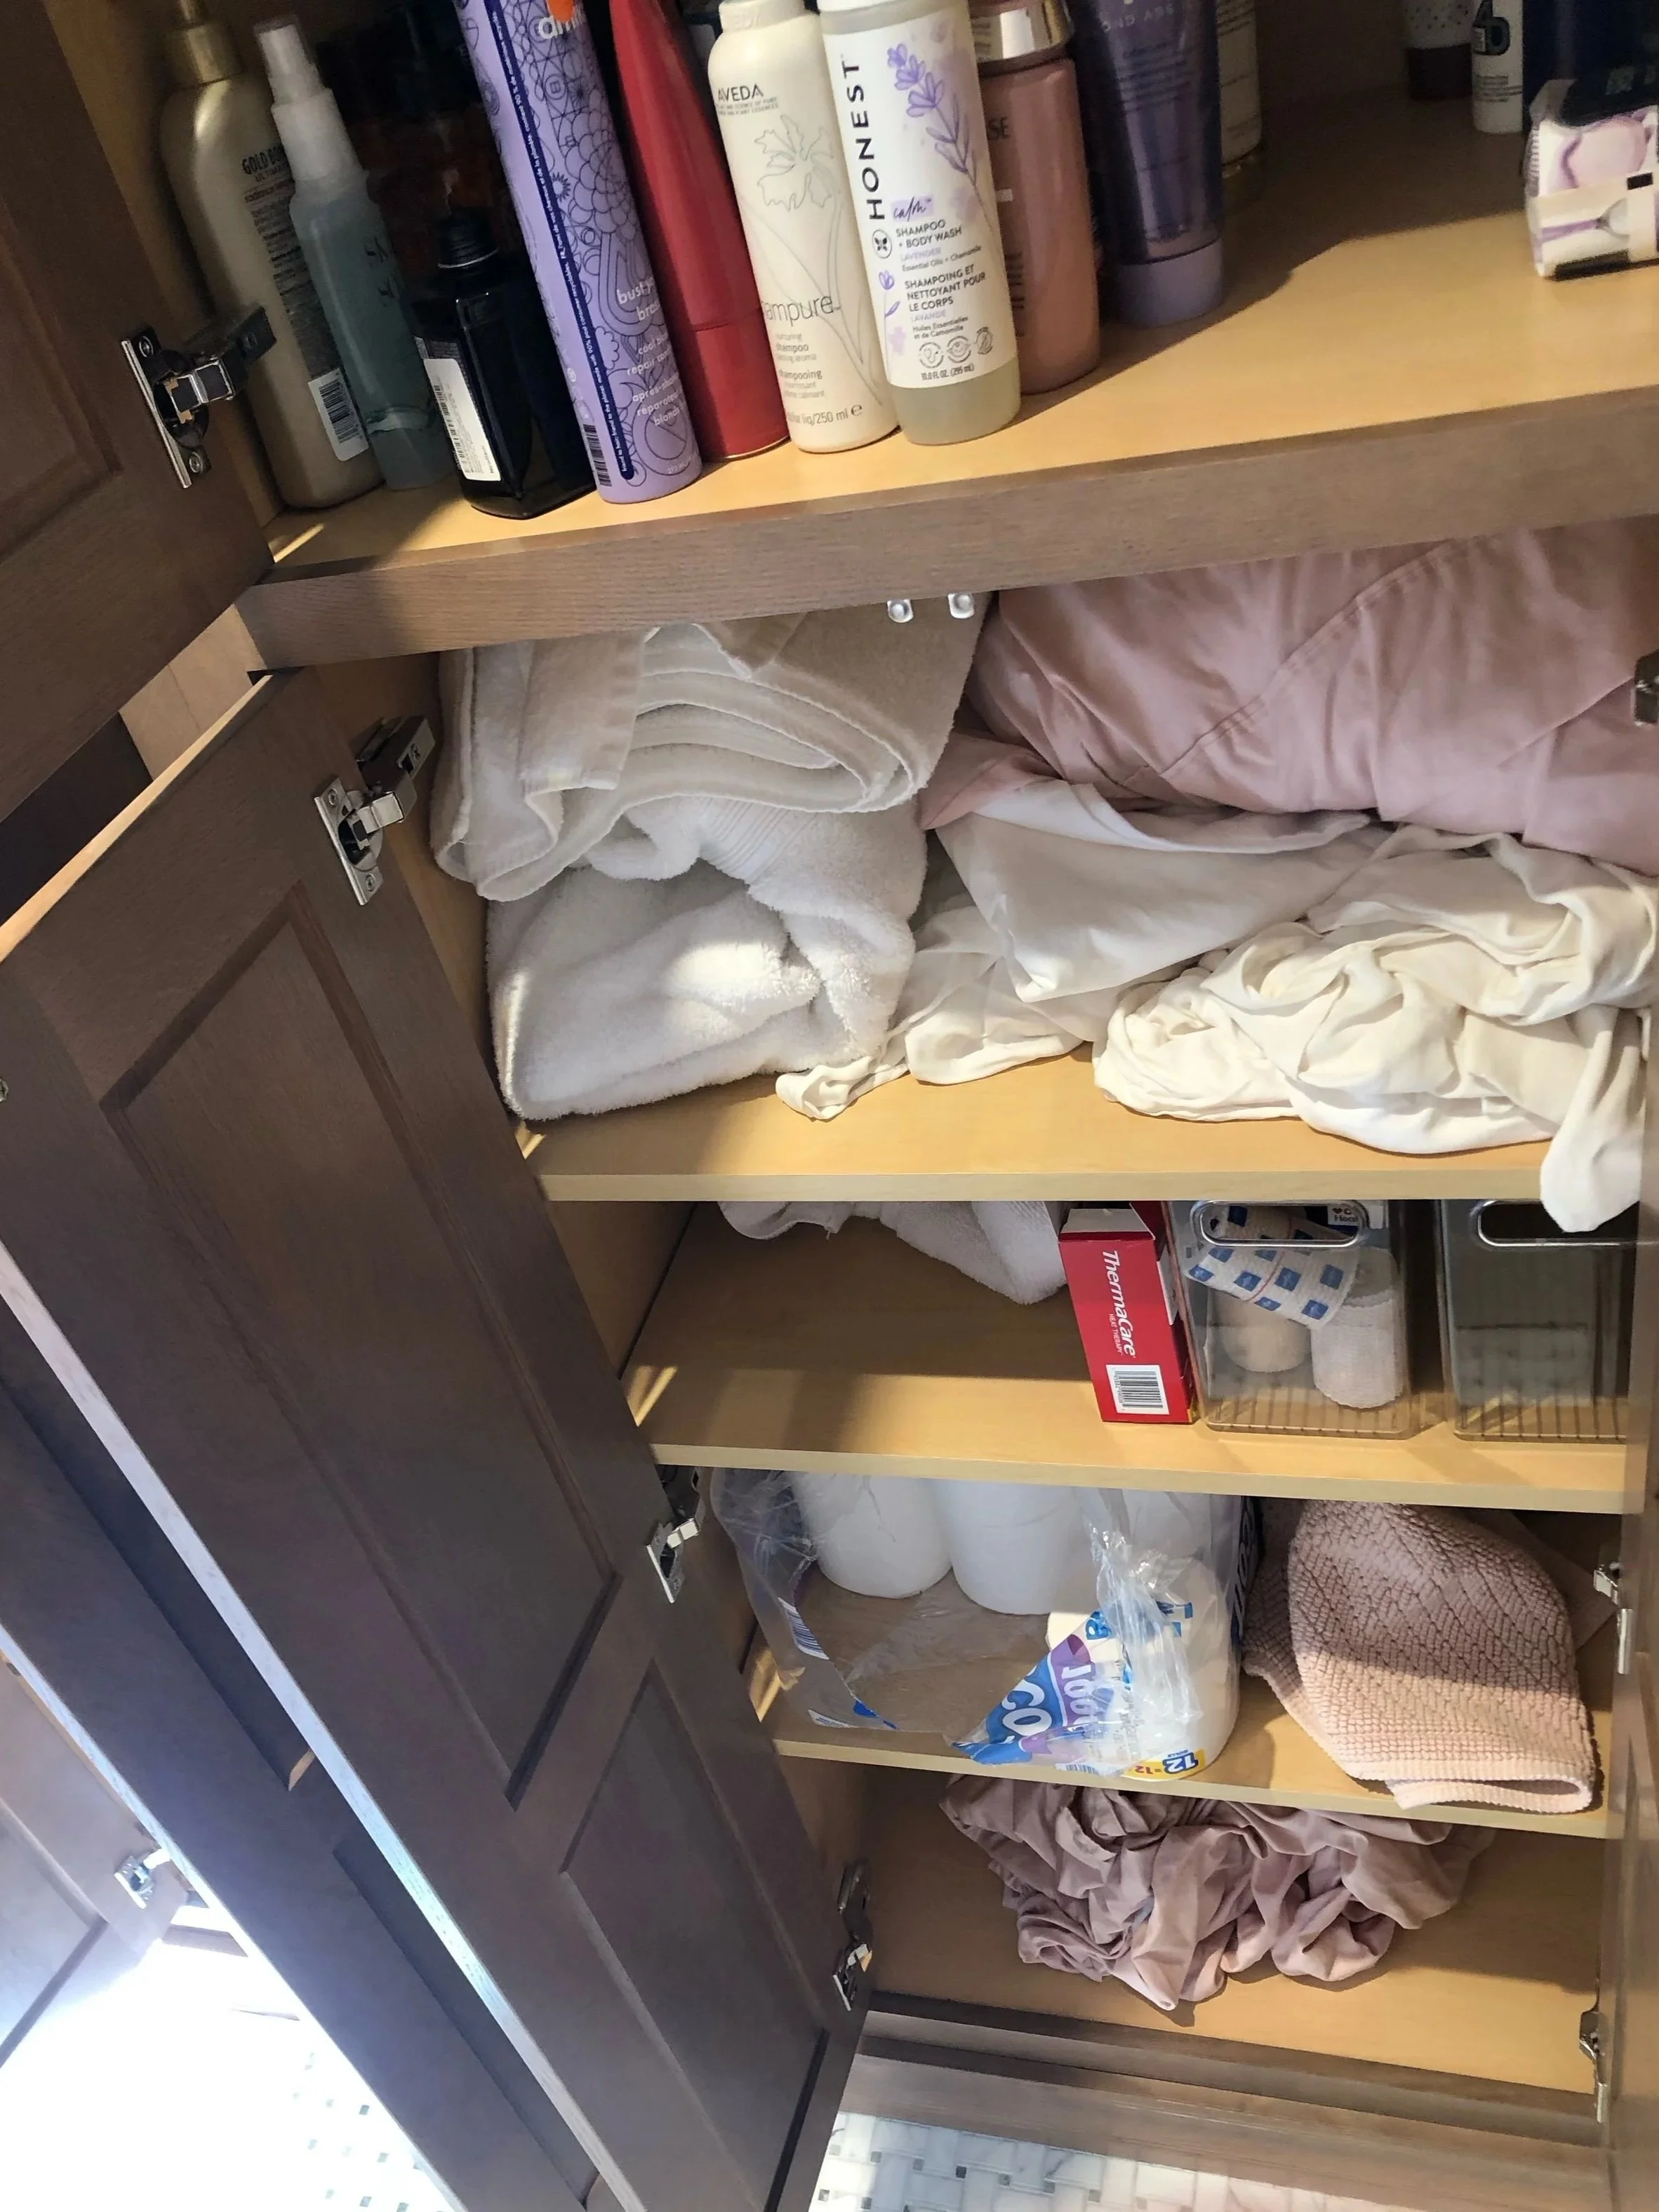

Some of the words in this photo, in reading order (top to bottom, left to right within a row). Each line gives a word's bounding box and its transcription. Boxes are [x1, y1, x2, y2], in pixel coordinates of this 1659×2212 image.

[718, 83, 764, 102] AVEDA
[841, 60, 885, 220] HONEST
[893, 196, 926, 222] calm
[895, 219, 946, 238] SHAMPOO
[906, 235, 933, 248] BODY
[935, 225, 962, 242] WASH
[905, 269, 964, 289] SHAMPOING
[965, 264, 975, 275] ET
[907, 281, 961, 300] NETTOYANT
[963, 272, 986, 288] POUR
[762, 295, 834, 326] ampure
[910, 302, 919, 312] LE
[921, 296, 954, 310] CORPS
[627, 359, 655, 377] repair
[1102, 1250, 1135, 1357] ThermaCare
[1112, 1328, 1122, 1354] THERAPY
[1164, 1752, 1197, 1774] 12
